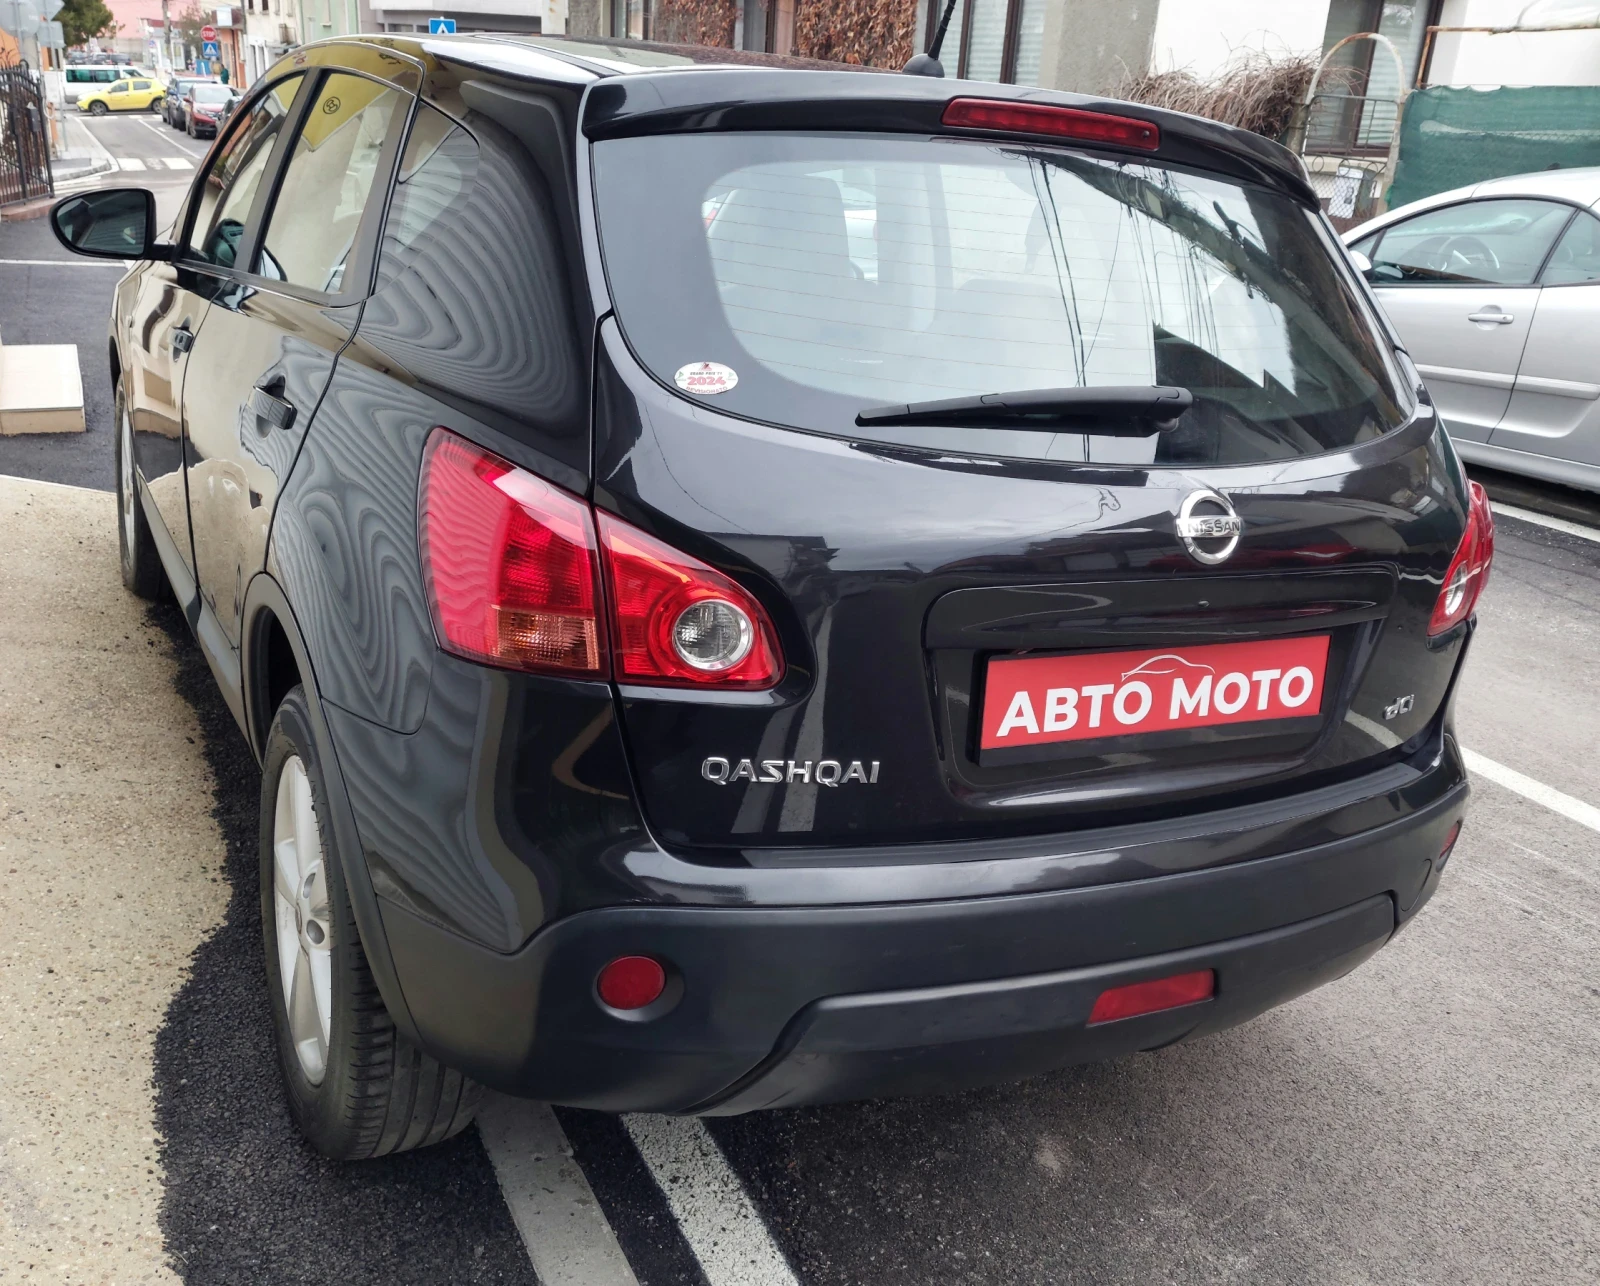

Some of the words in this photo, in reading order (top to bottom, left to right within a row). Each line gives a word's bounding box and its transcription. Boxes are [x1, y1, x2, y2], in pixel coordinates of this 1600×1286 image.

[202, 30, 215, 38] STOP
[687, 376, 726, 386] 2024
[1187, 520, 1240, 534] NISSAN
[996, 680, 1153, 737] АВТО
[1168, 666, 1315, 721] МОТО
[701, 757, 881, 787] QASHQAI
